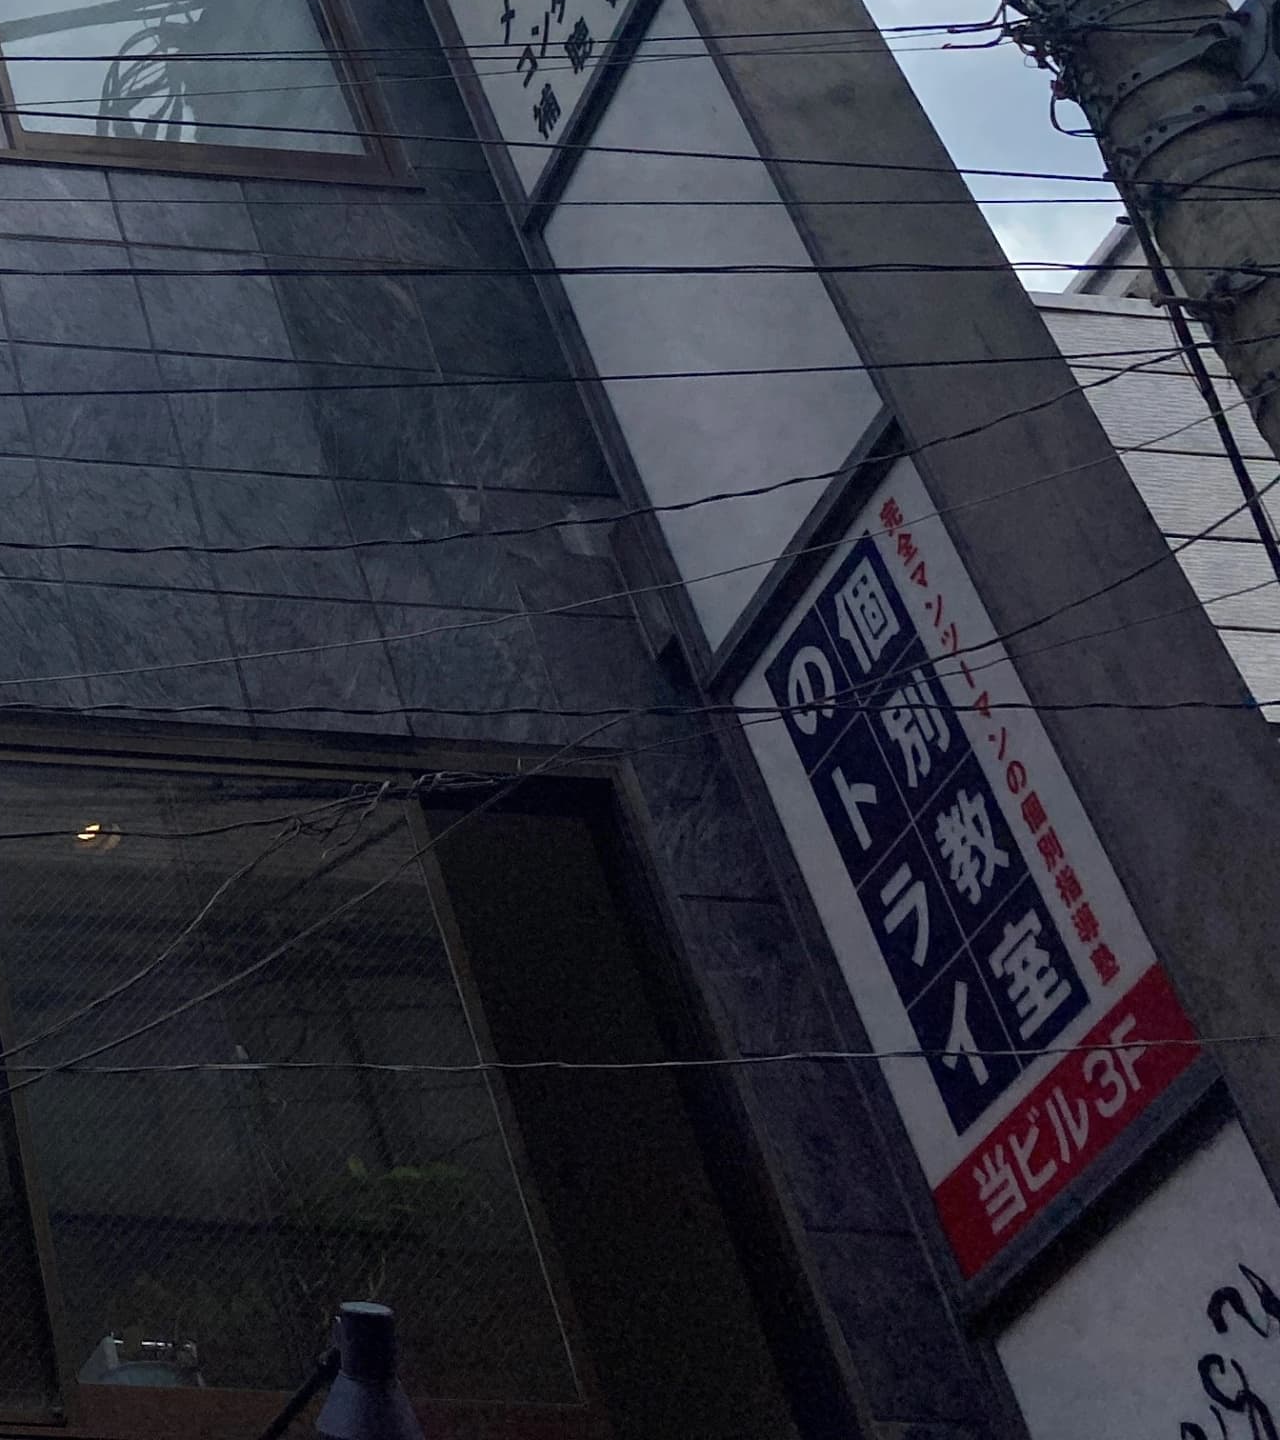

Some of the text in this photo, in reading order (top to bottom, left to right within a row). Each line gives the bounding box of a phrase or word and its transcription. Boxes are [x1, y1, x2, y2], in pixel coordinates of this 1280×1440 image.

[787, 645, 989, 1086] のトライ
[834, 561, 1072, 1040] 個別教室
[972, 1014, 1149, 1236] 当ビル3F
